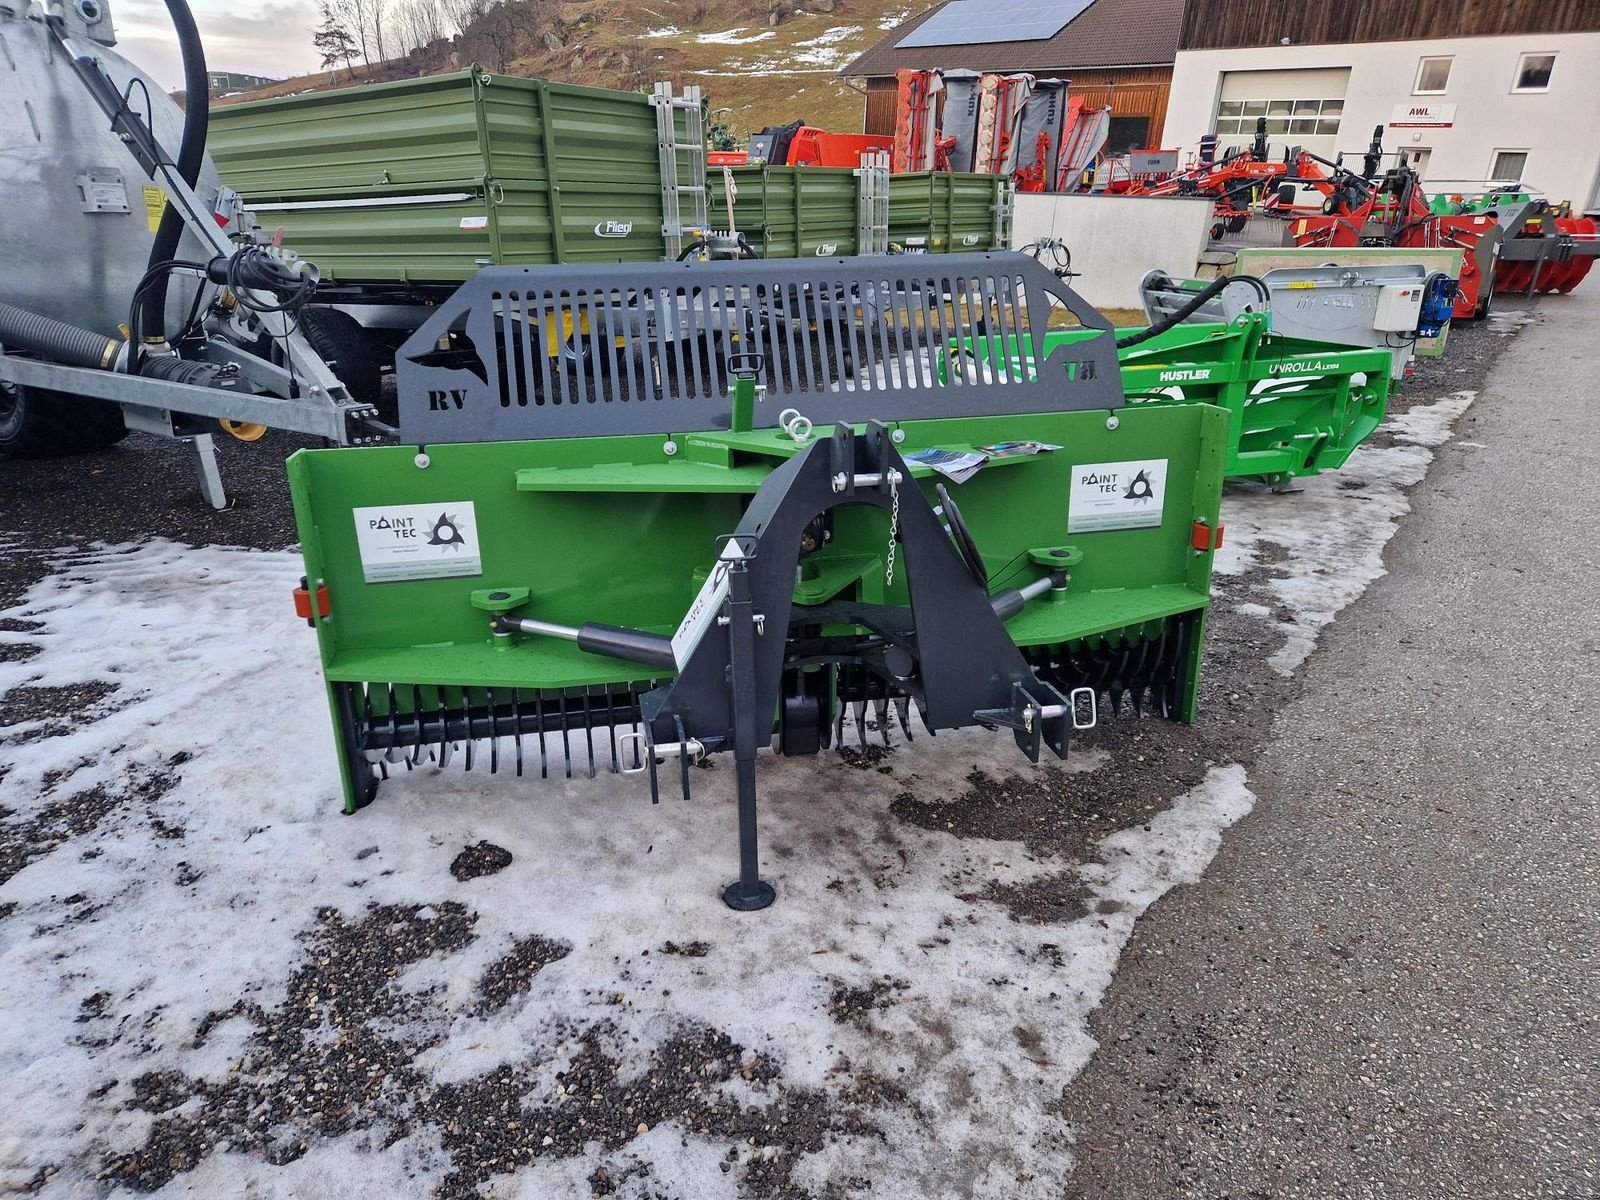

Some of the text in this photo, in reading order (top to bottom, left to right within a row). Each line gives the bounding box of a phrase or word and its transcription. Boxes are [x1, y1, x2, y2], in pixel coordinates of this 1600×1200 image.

[1046, 91, 1057, 125] KUHN
[1408, 107, 1430, 116] AWL
[604, 220, 632, 235] Fliegl
[1268, 360, 1322, 374] UNROLLA
[1159, 369, 1212, 382] HUSTLER
[428, 389, 467, 411] RV
[1099, 484, 1117, 493] TEC
[394, 528, 417, 539] TEC
